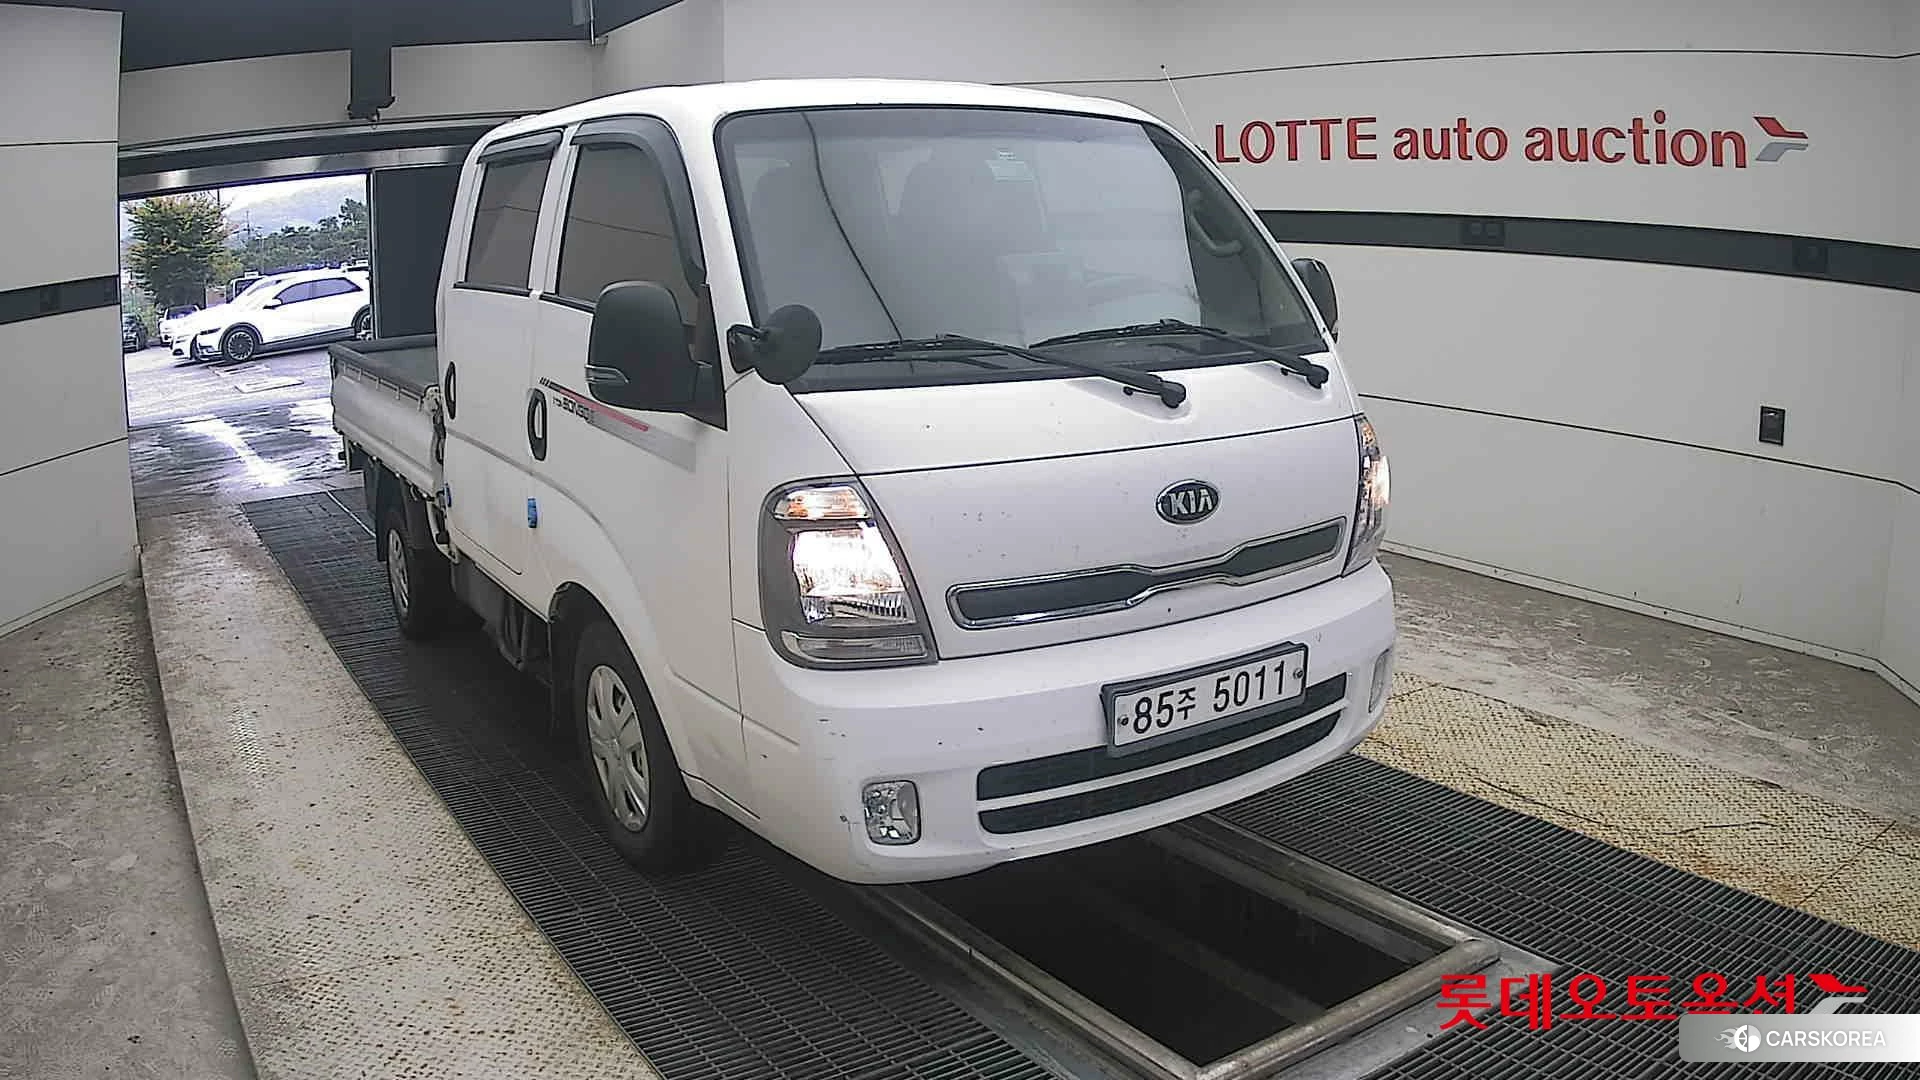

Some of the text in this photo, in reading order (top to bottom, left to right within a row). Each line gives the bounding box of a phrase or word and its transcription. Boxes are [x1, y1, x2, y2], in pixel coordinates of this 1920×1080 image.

[1214, 109, 1747, 169] LOTTE auto auction
[1168, 488, 1213, 516] KIA
[1133, 660, 1285, 734] 85주 5011
